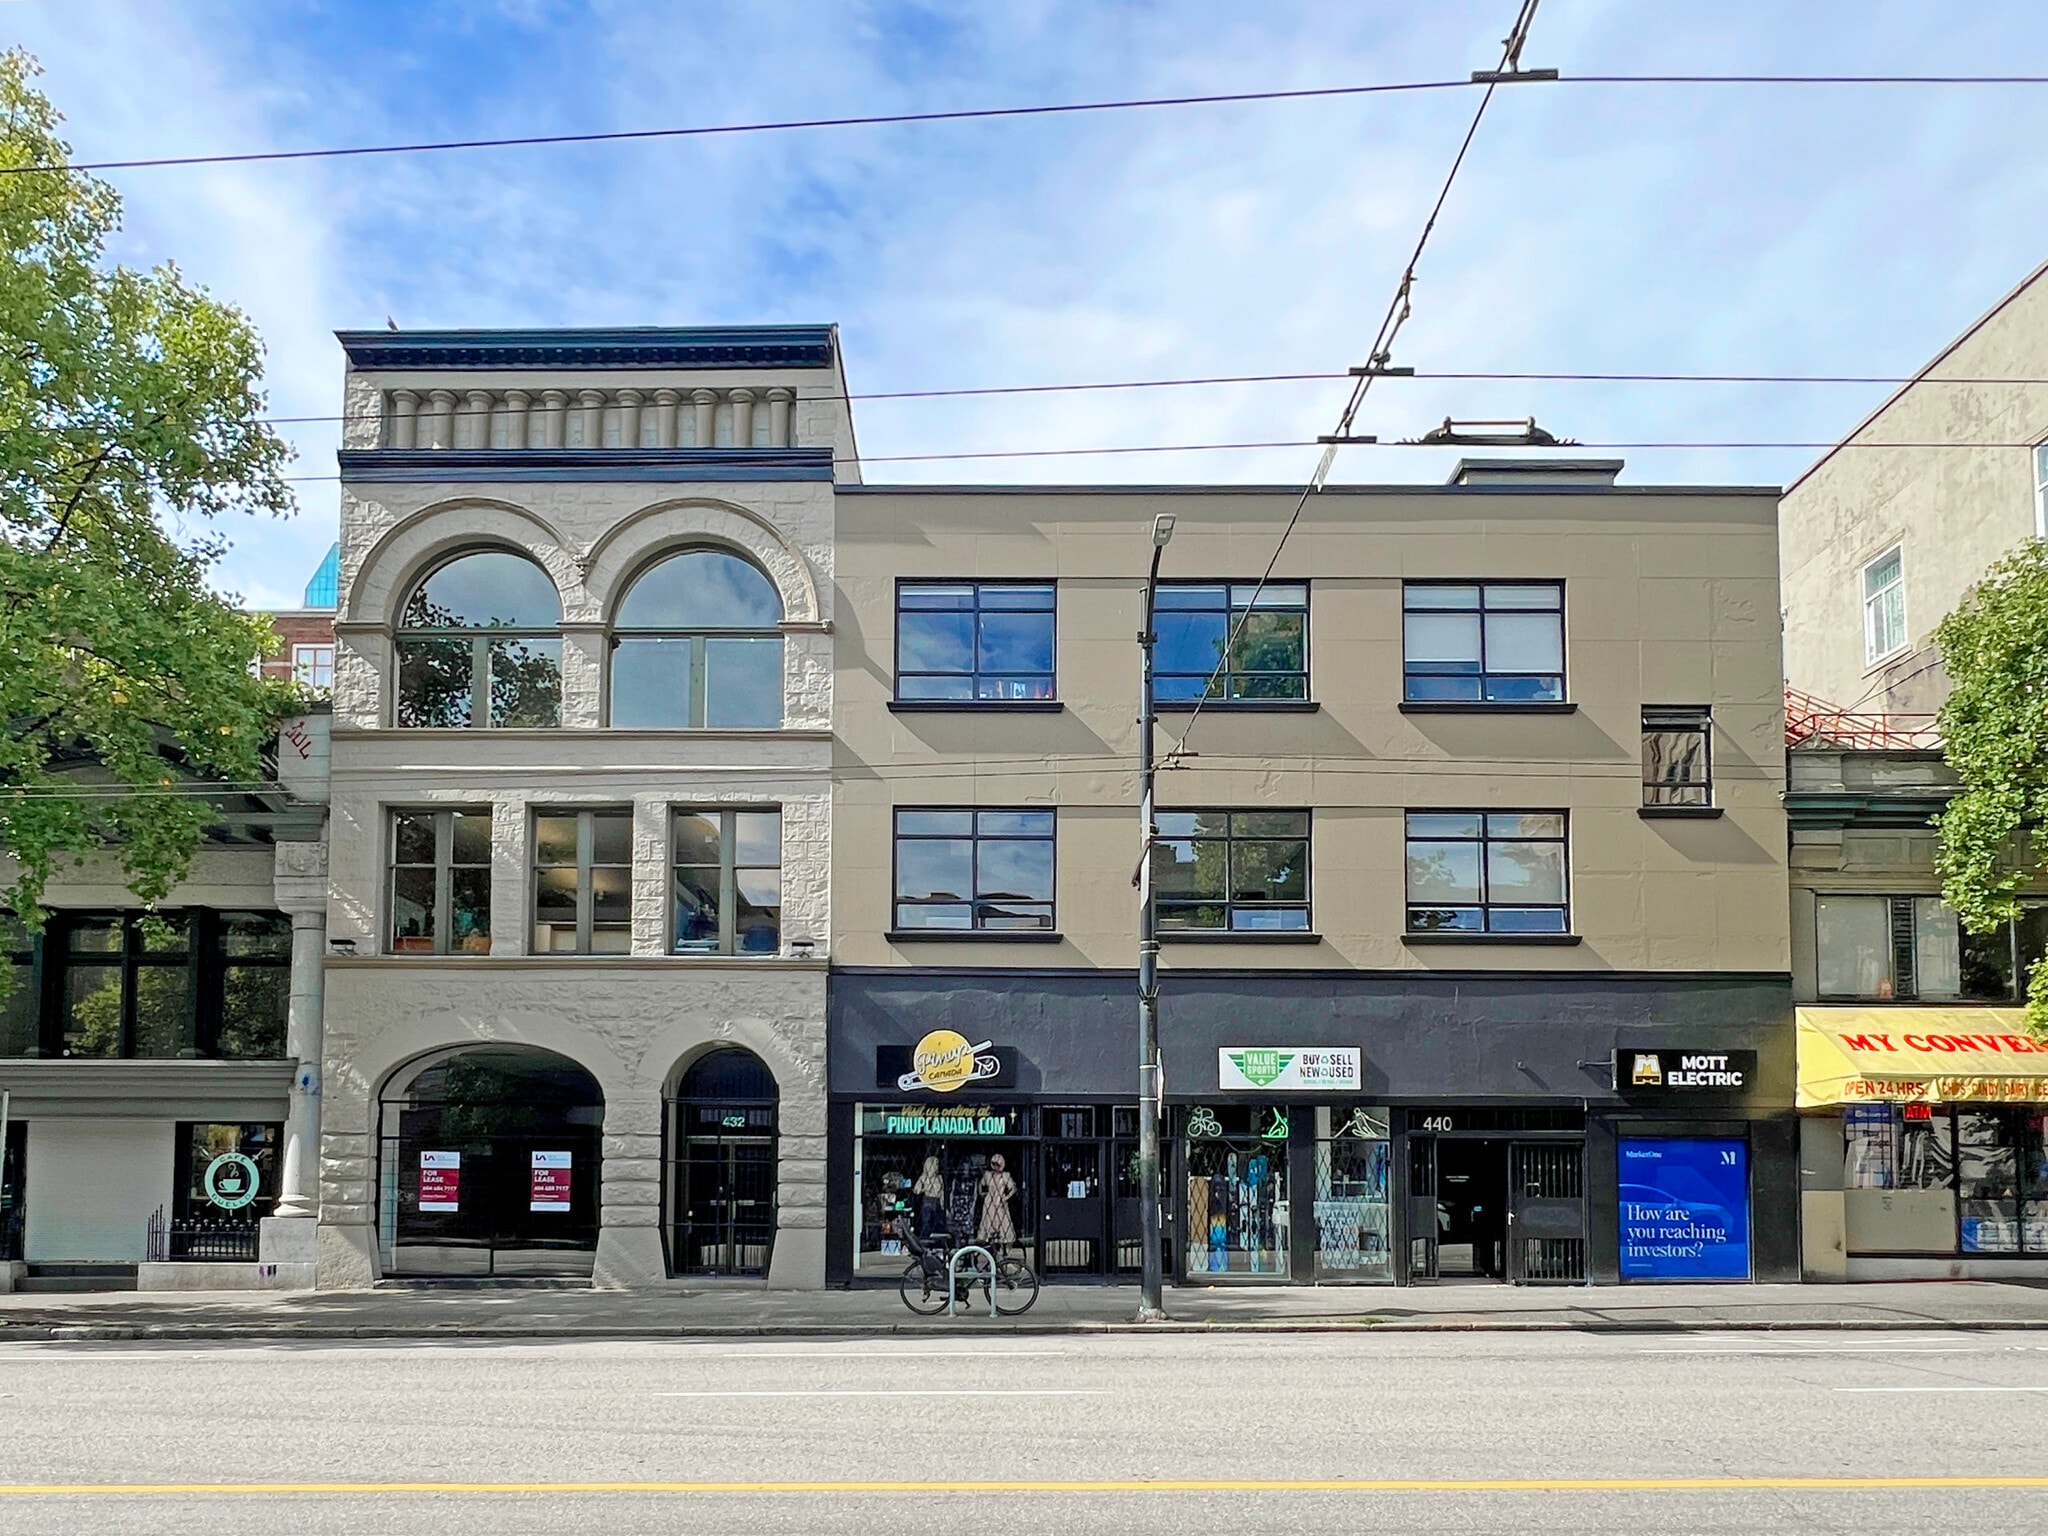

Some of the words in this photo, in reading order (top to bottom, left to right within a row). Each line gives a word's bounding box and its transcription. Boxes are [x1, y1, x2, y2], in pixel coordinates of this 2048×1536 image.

[1838, 1034, 1898, 1051] MY
[1246, 1053, 1276, 1065] VALUE
[1303, 1054, 1320, 1065] BUY
[1330, 1054, 1353, 1065] SELL
[1681, 1056, 1728, 1070] MOTT
[928, 1068, 962, 1080] CANADA
[1247, 1065, 1276, 1075] SPORTS
[1300, 1067, 1320, 1077] NEW
[1329, 1067, 1353, 1077] USED
[1668, 1071, 1742, 1086] ELECTRIC
[1845, 1081, 1875, 1096] OPEN
[1878, 1081, 1894, 1095] 24
[901, 1104, 925, 1117] Visit
[926, 1107, 940, 1117] us
[941, 1104, 975, 1117] online
[977, 1105, 991, 1117] at
[1906, 1106, 1931, 1118] ATM
[722, 1116, 745, 1127] 432
[887, 1116, 1006, 1135] PINUPCANADA.COM
[1423, 1116, 1452, 1131] 440
[219, 1154, 247, 1163] CAFE
[211, 1193, 251, 1207] DUELLO
[1627, 1205, 1661, 1221] How
[1665, 1210, 1690, 1221] are
[1627, 1228, 1655, 1242] you
[1659, 1223, 1727, 1243] reaching
[1628, 1242, 1704, 1258] investors?
